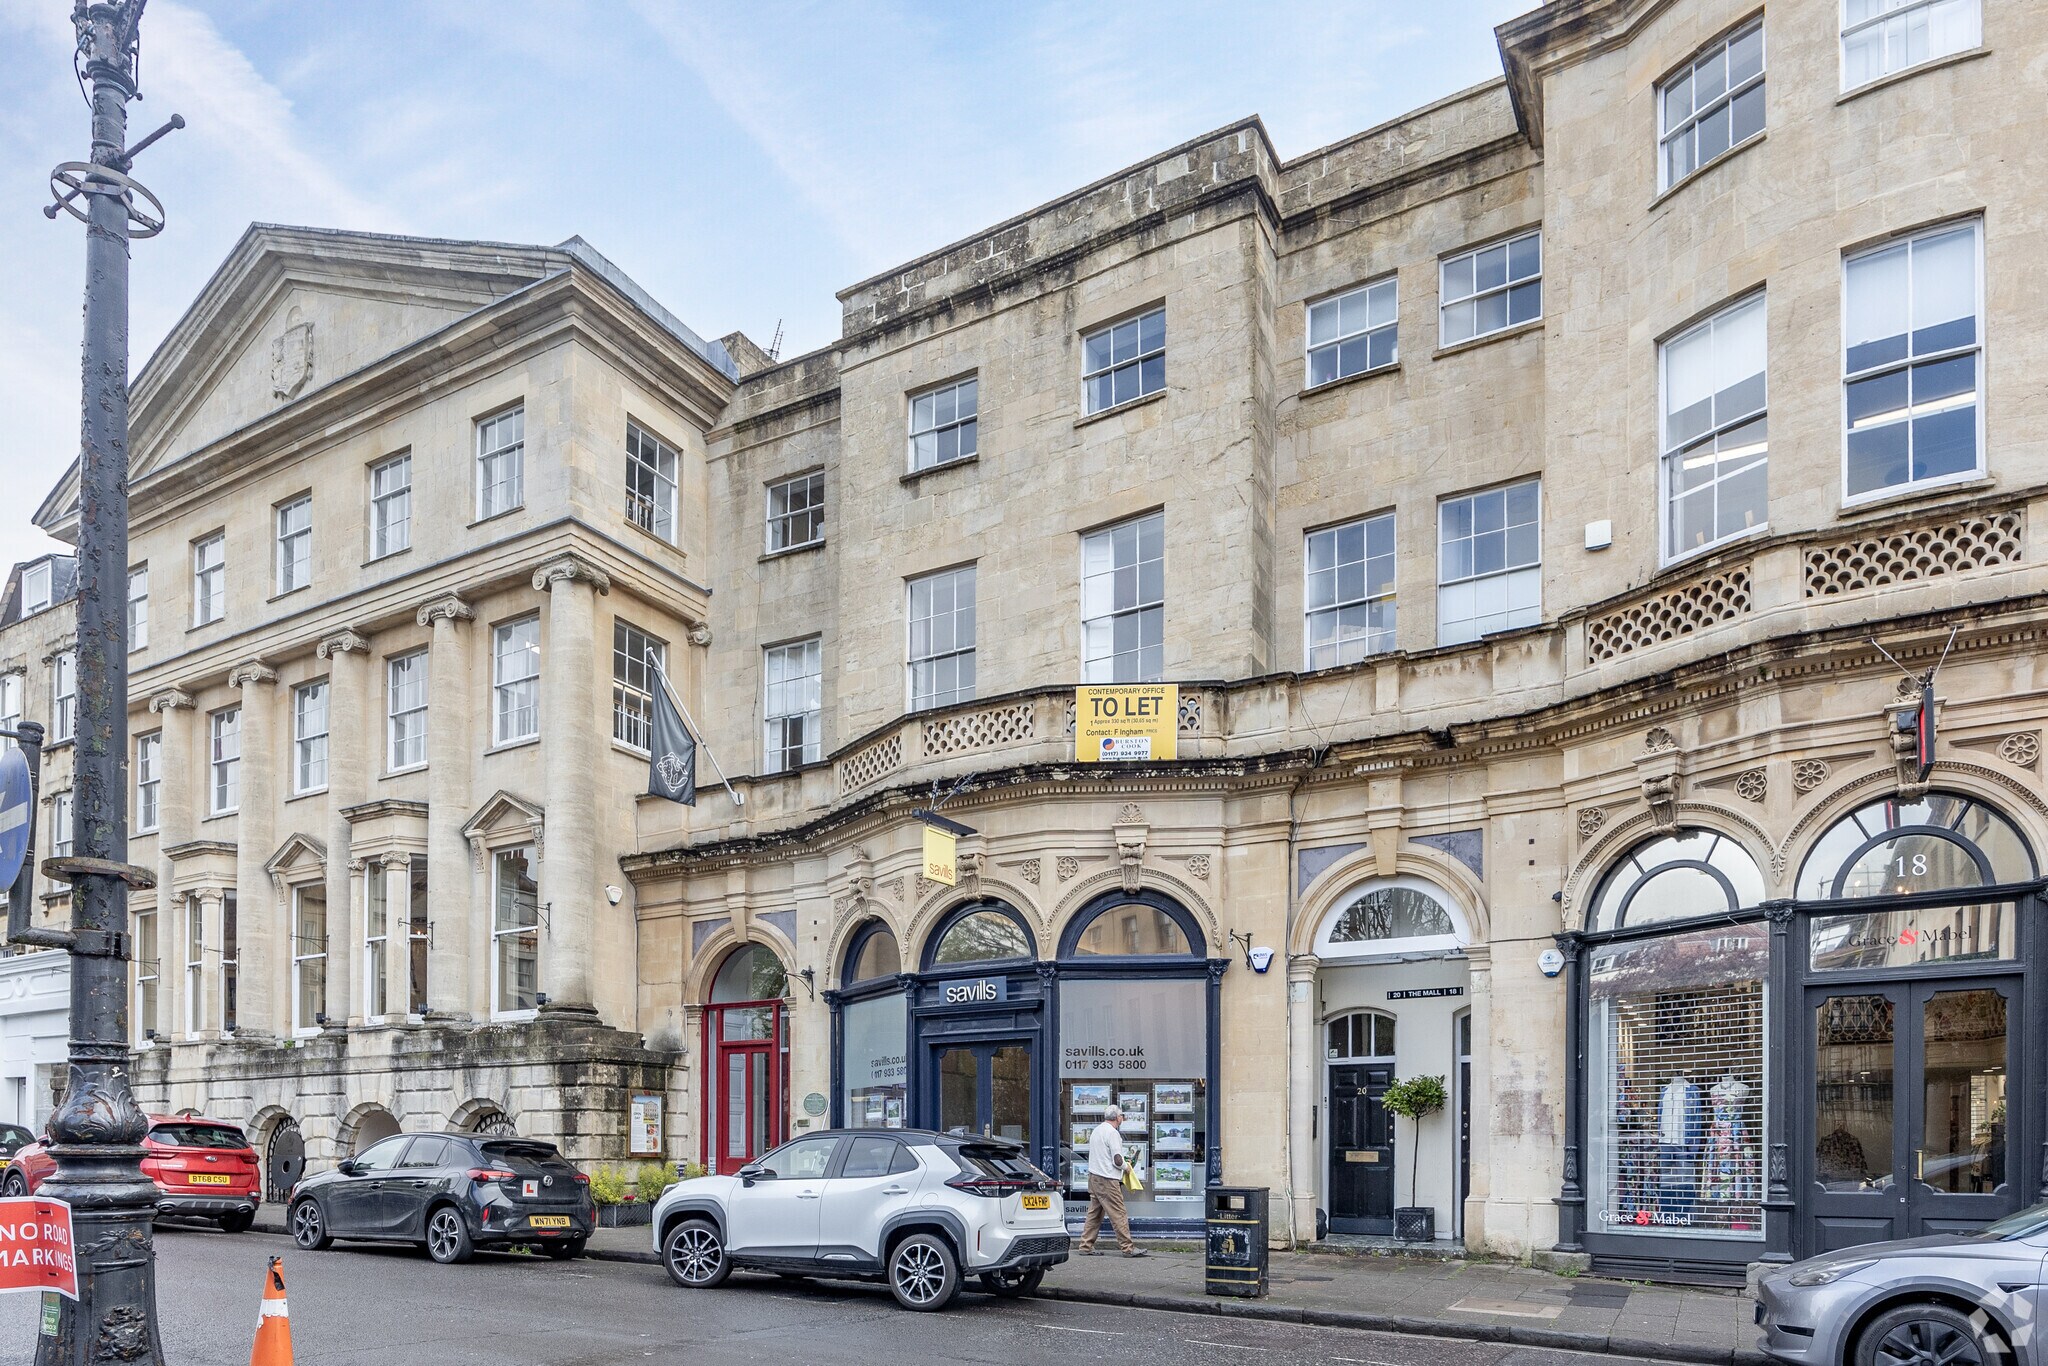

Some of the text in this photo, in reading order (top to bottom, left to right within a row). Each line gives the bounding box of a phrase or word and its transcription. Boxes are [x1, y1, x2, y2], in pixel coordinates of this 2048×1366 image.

[1090, 696, 1163, 717] TO LET
[1120, 729, 1143, 737] Ingham
[929, 862, 953, 881] savills
[1895, 854, 1928, 878] 18
[1848, 925, 1972, 947] Grace & Mabel
[946, 979, 997, 1003] savills
[1065, 1045, 1144, 1057] savills.co.uk
[871, 1055, 906, 1068] savills.co.u
[1065, 1060, 1147, 1069] 0117 933 5800
[883, 1067, 895, 1078] 933
[1357, 1087, 1367, 1095] 20
[192, 1175, 212, 1183] BT68
[526, 1183, 534, 1193] L
[1219, 1212, 1238, 1220] Litter
[1598, 1209, 1691, 1226] Grace & Mabel
[0, 1222, 68, 1245] NO ROAD
